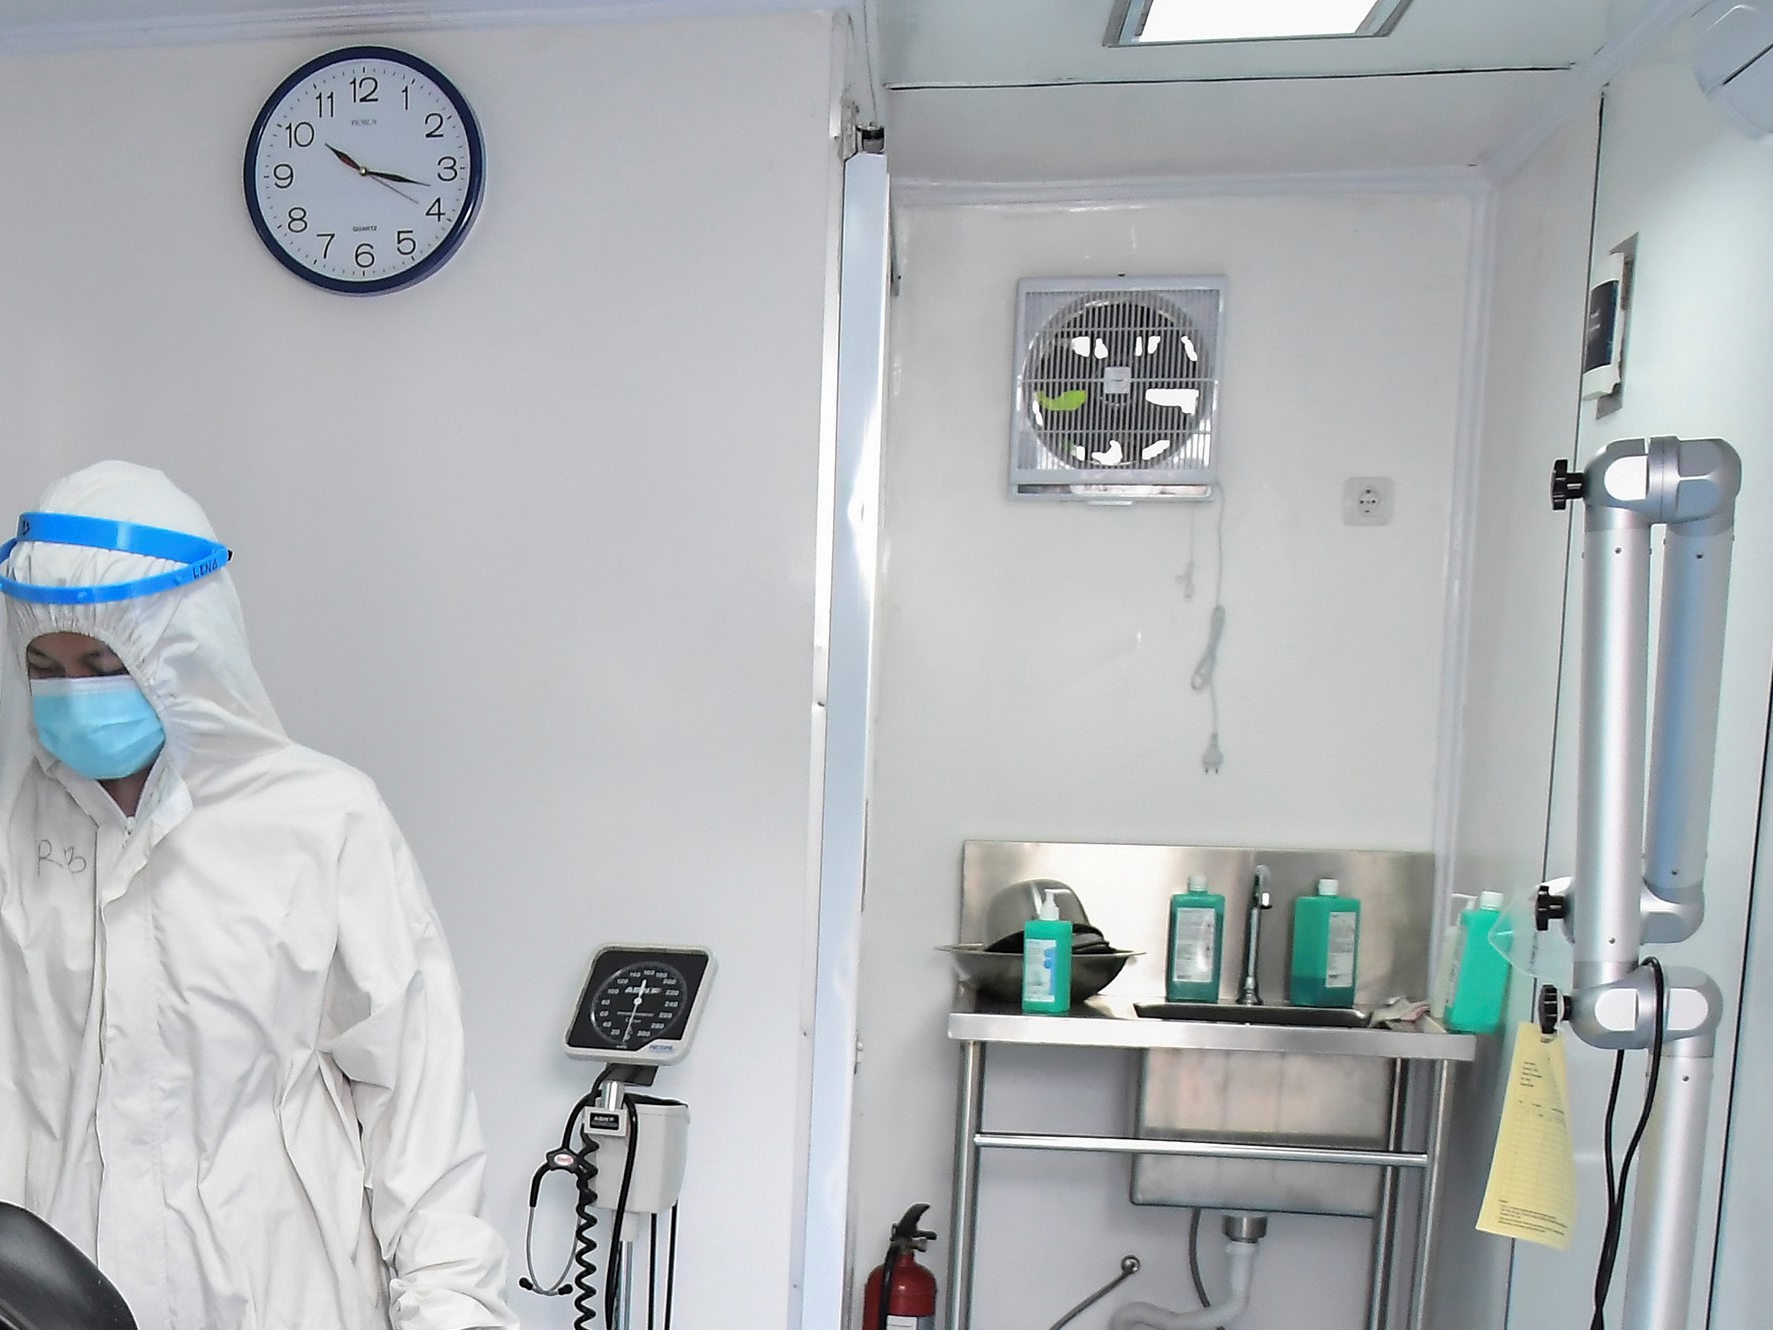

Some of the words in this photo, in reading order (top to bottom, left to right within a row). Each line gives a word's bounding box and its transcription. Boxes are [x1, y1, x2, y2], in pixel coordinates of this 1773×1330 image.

[349, 77, 379, 103] 12
[401, 85, 409, 111] 1
[315, 91, 335, 118] 11
[285, 121, 315, 148] 10
[424, 113, 444, 138] 2
[273, 163, 293, 188] 9
[437, 156, 458, 182] 3
[287, 207, 308, 233] 8
[425, 197, 446, 222] 4
[316, 233, 336, 259] 7
[354, 243, 375, 268] 6
[396, 230, 416, 255] 5
